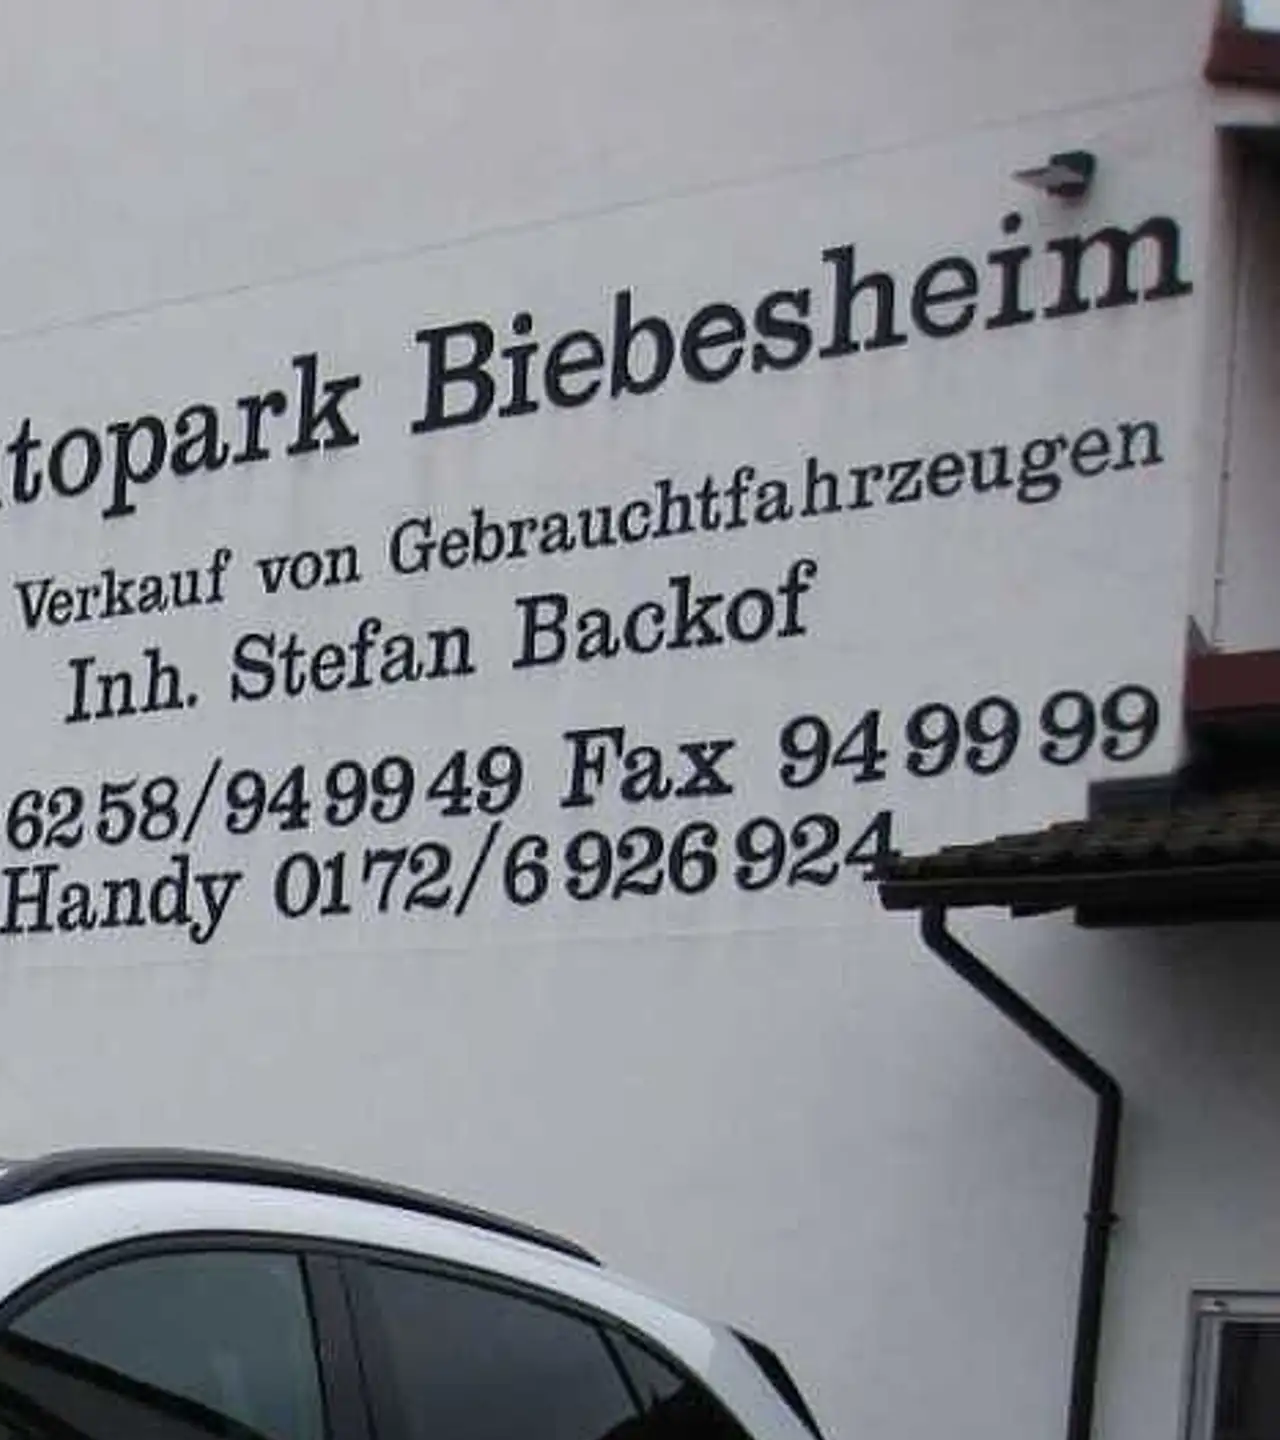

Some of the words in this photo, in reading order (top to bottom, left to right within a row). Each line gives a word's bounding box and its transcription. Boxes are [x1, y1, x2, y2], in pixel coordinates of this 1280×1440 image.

[409, 210, 1193, 434] Biebesheim
[14, 548, 233, 629] Verkauf
[256, 544, 359, 593] von
[389, 419, 1163, 574] Gebrauchtfahrzeugen
[65, 648, 197, 723] Inh.
[231, 618, 474, 701] Stefan
[511, 560, 818, 670] Backof
[559, 726, 736, 809] Fax
[0, 855, 243, 943] Handy
